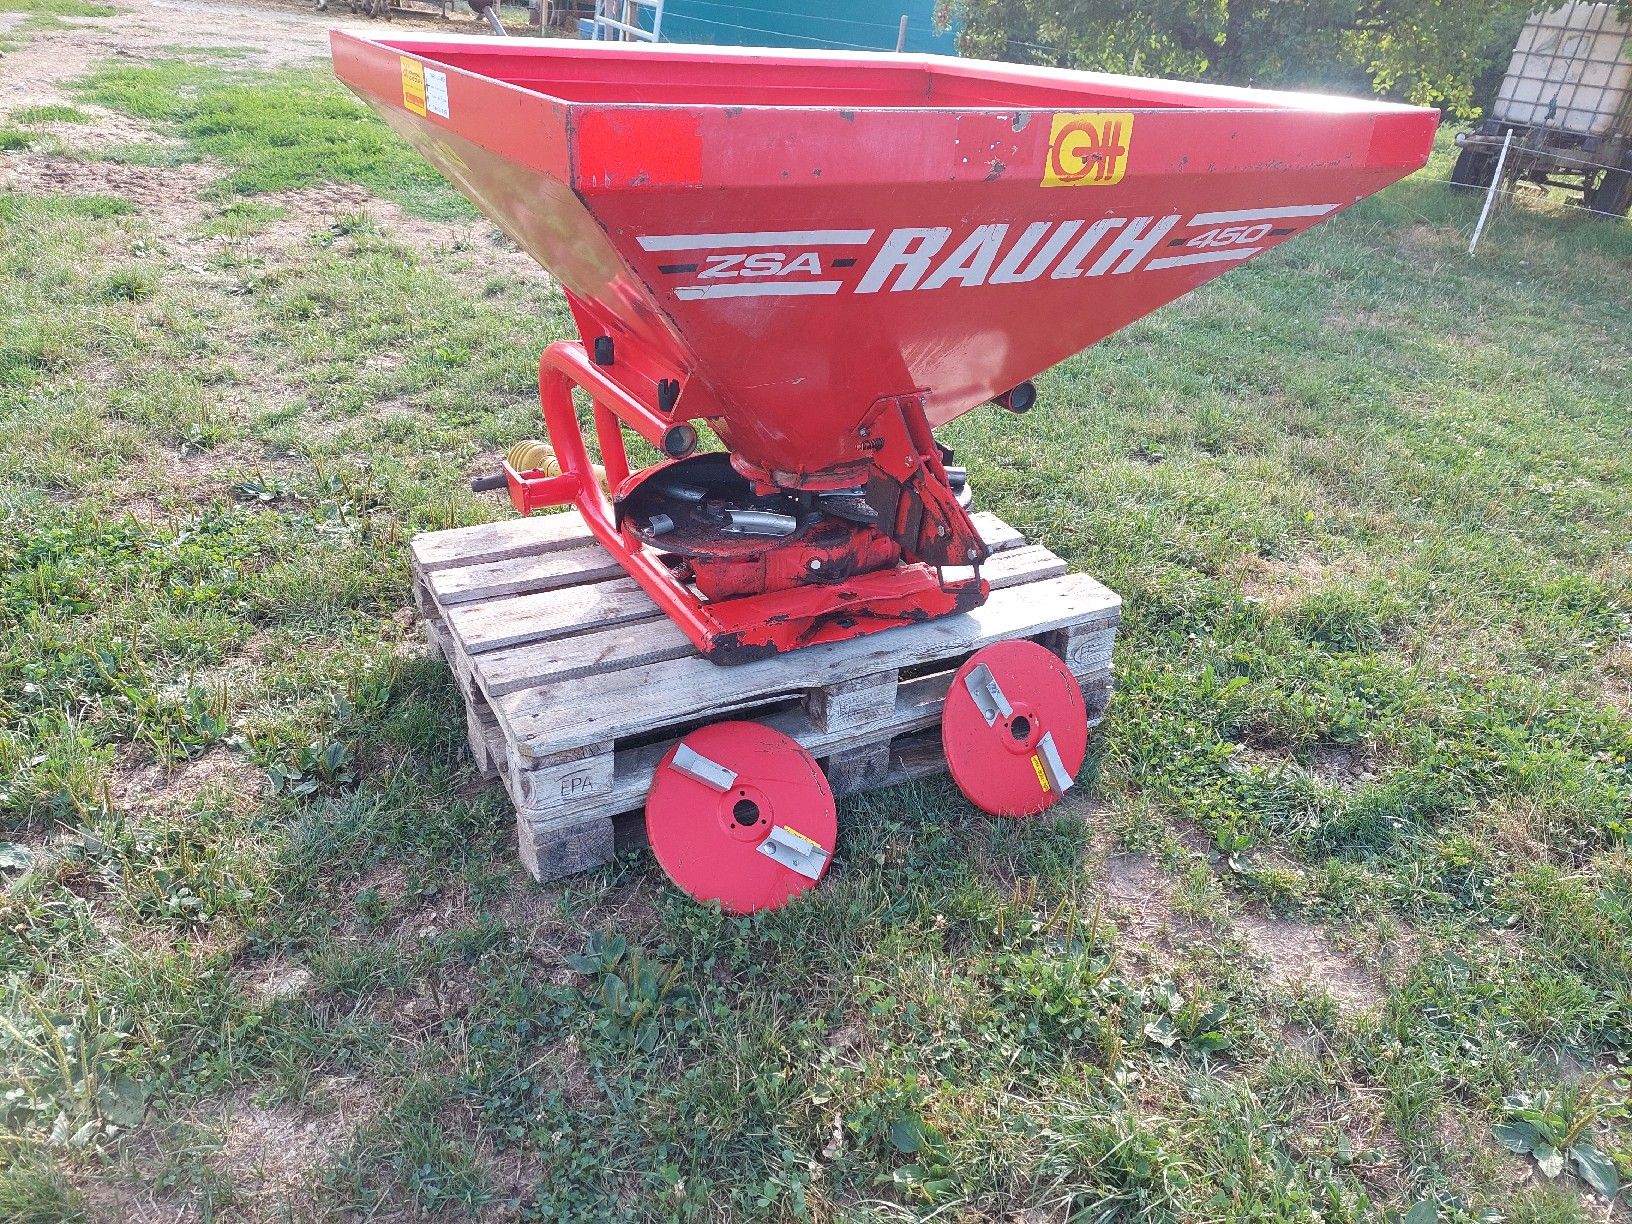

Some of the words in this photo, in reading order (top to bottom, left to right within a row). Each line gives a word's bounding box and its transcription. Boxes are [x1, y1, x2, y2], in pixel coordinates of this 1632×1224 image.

[697, 252, 822, 278] ZSA
[853, 214, 1182, 294] RAUCH
[1185, 223, 1273, 249] 450
